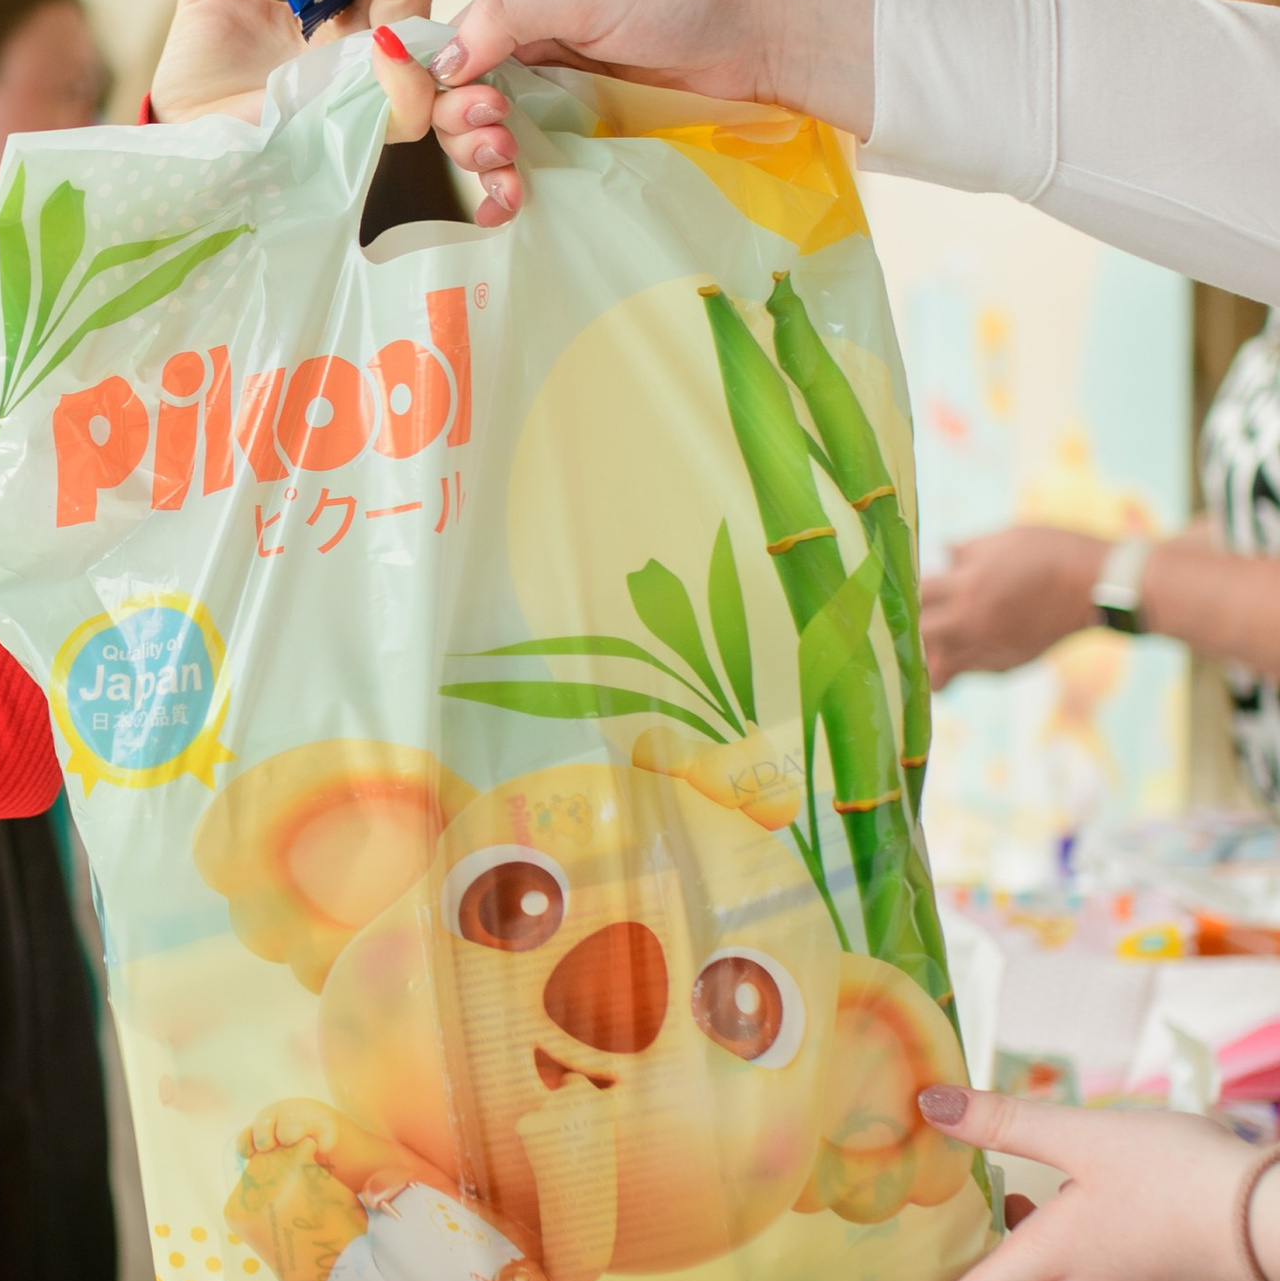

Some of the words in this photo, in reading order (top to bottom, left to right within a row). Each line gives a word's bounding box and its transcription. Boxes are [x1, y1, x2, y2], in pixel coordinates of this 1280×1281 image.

[52, 285, 472, 528] pikool
[102, 642, 163, 661] Quality
[166, 632, 184, 652] of
[79, 661, 202, 709] Japan
